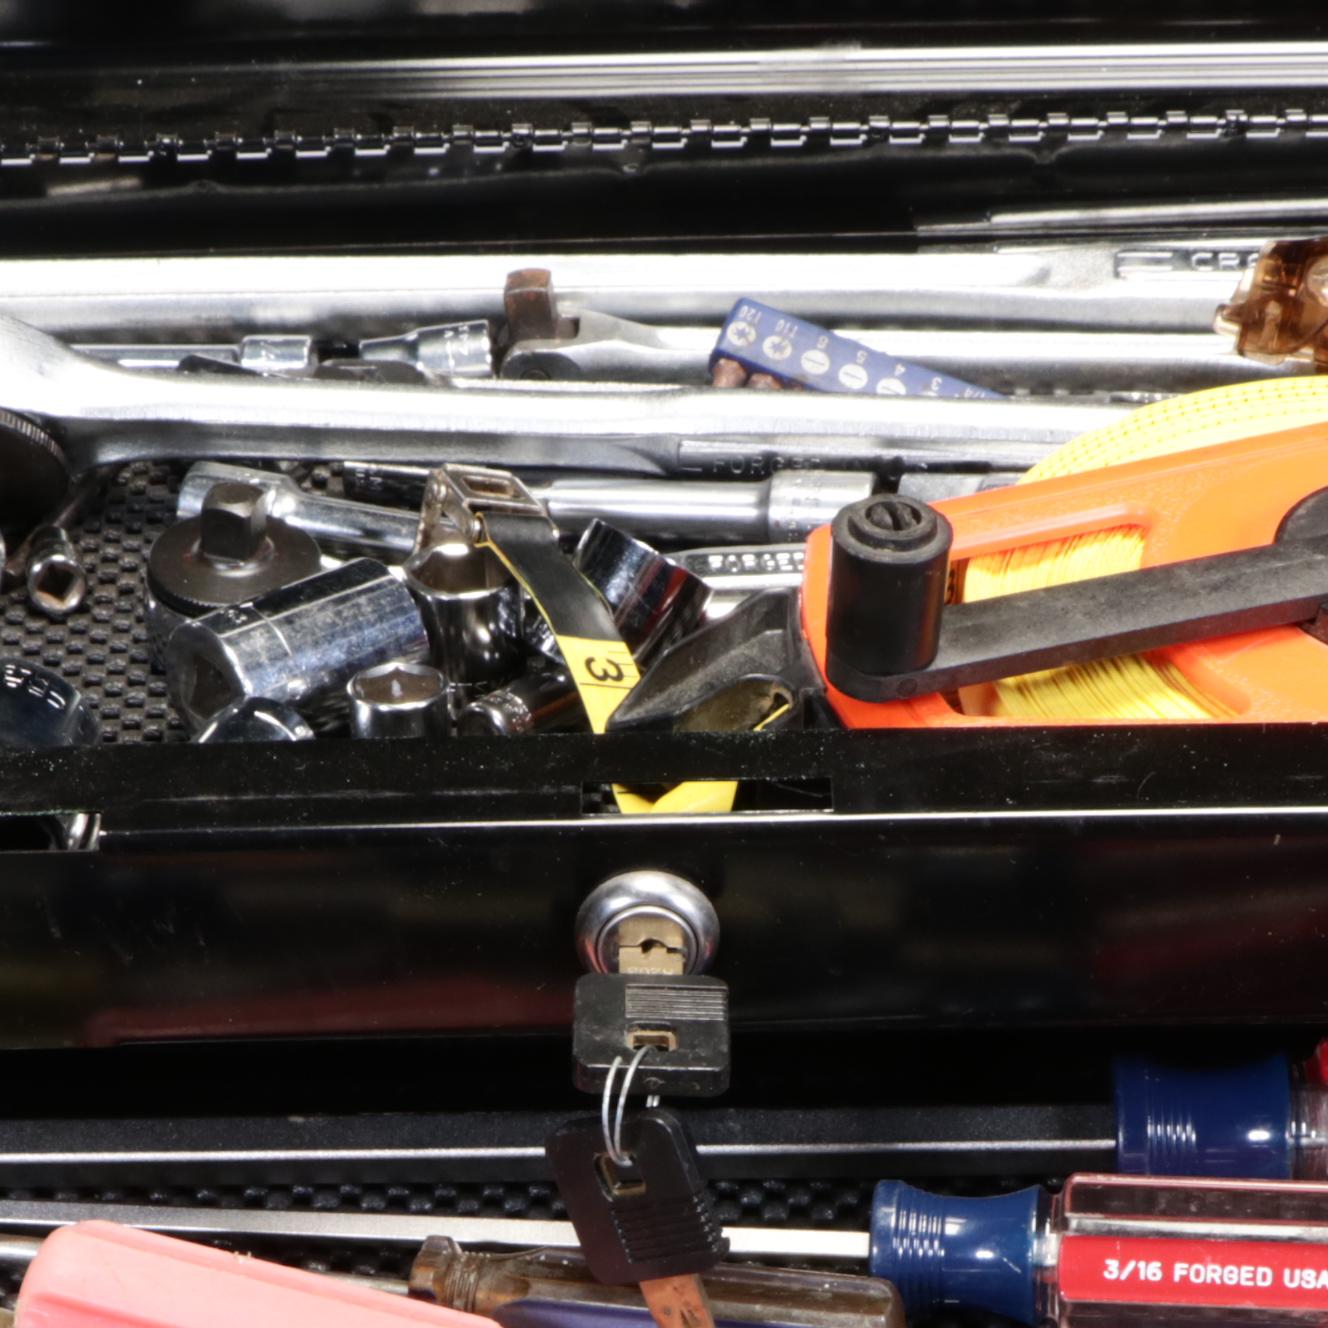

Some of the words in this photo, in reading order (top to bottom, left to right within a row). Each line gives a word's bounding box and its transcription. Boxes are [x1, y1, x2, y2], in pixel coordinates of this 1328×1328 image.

[584, 656, 624, 682] 3
[1102, 1258, 1163, 1282] 3/16
[1173, 1261, 1273, 1287] FORGED
